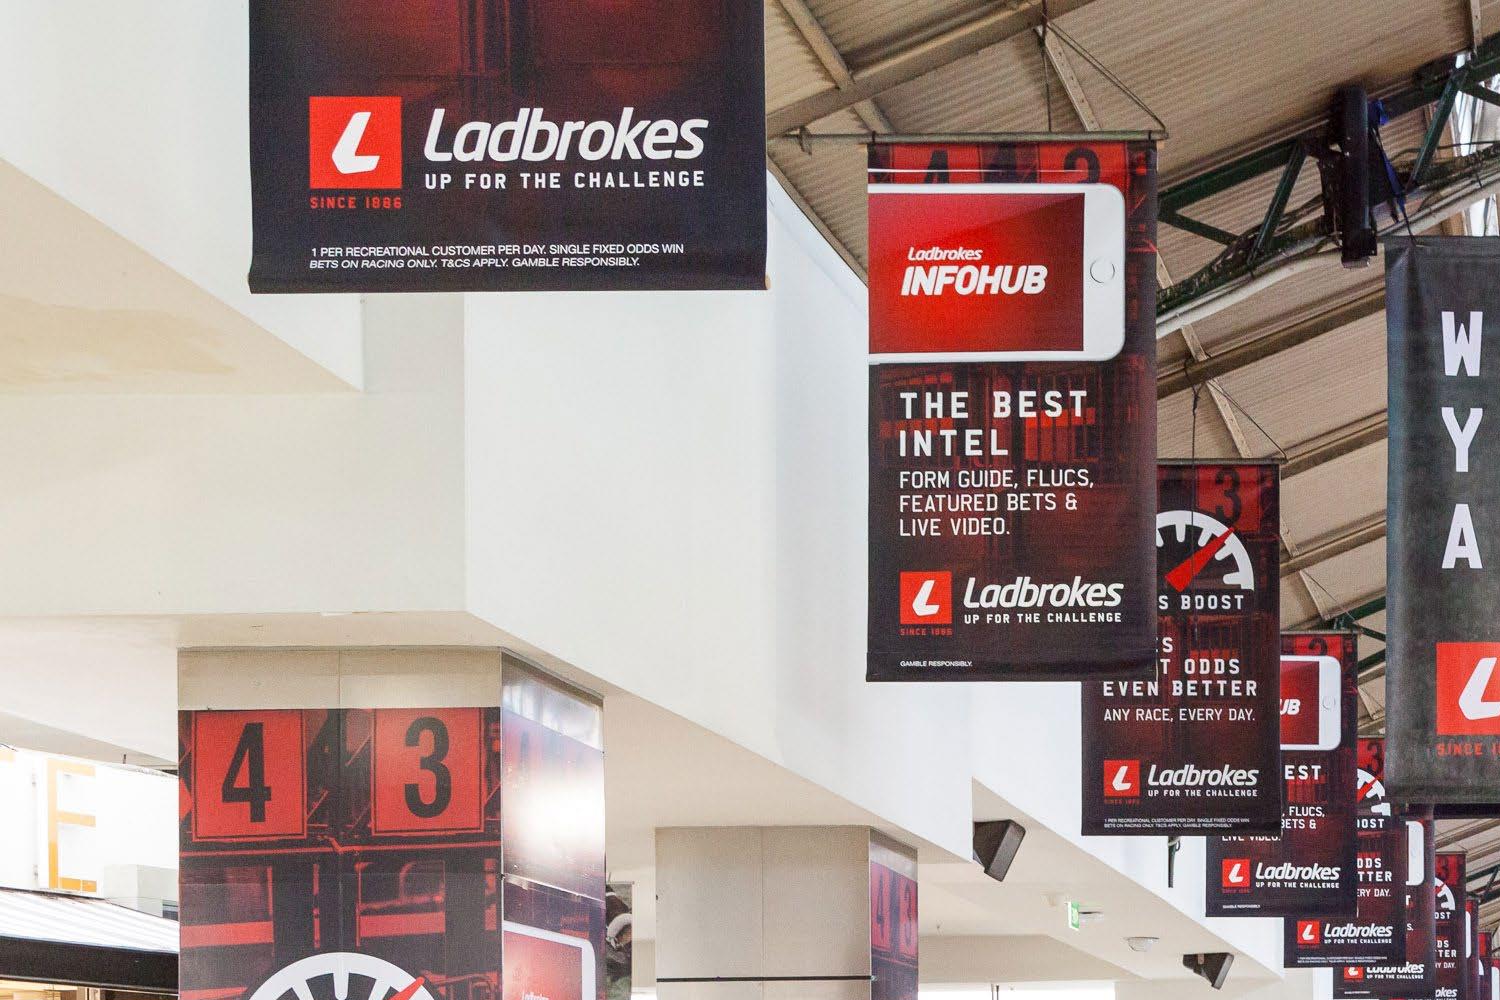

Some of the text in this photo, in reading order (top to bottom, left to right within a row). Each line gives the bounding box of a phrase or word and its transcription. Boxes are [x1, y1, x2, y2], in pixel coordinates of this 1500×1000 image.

[424, 107, 709, 162] Ladbrokes
[425, 170, 704, 189] UP FOR THE CHALLENGE
[311, 197, 355, 208] SINCE
[312, 243, 684, 257] 1 PER RECREATIONAL CUSTOMER PER DAY. SINGLE FIXED ODDS WIN
[908, 247, 983, 261] Ladbrokes
[309, 257, 640, 269] BETS ON RACING ONLY. T&CS APPLY. GAMBLE RESPONSIBLY.
[901, 265, 1048, 296] INFOHUB
[900, 390, 1087, 419] THE BEST
[900, 429, 1008, 457] INTEL
[900, 469, 1093, 489] FORM GUIDE, FLUCS,
[900, 493, 1077, 513] FEATURED BETS &
[900, 517, 1010, 536] LIVE VIDEO.
[963, 576, 1124, 608] Ladbrokes
[1181, 595, 1244, 610] BOOST
[1184, 658, 1239, 674] ODDS
[1103, 679, 1257, 696] EVEN BETTER
[1104, 708, 1255, 722] ANY RACE, EVERY DAY.
[221, 716, 452, 823] 4 3
[1148, 764, 1259, 786] Ladbrokes
[1289, 806, 1325, 817] FLUCS,
[1255, 862, 1341, 880] Ladbrokes
[1324, 923, 1393, 937] Ladbrokes
